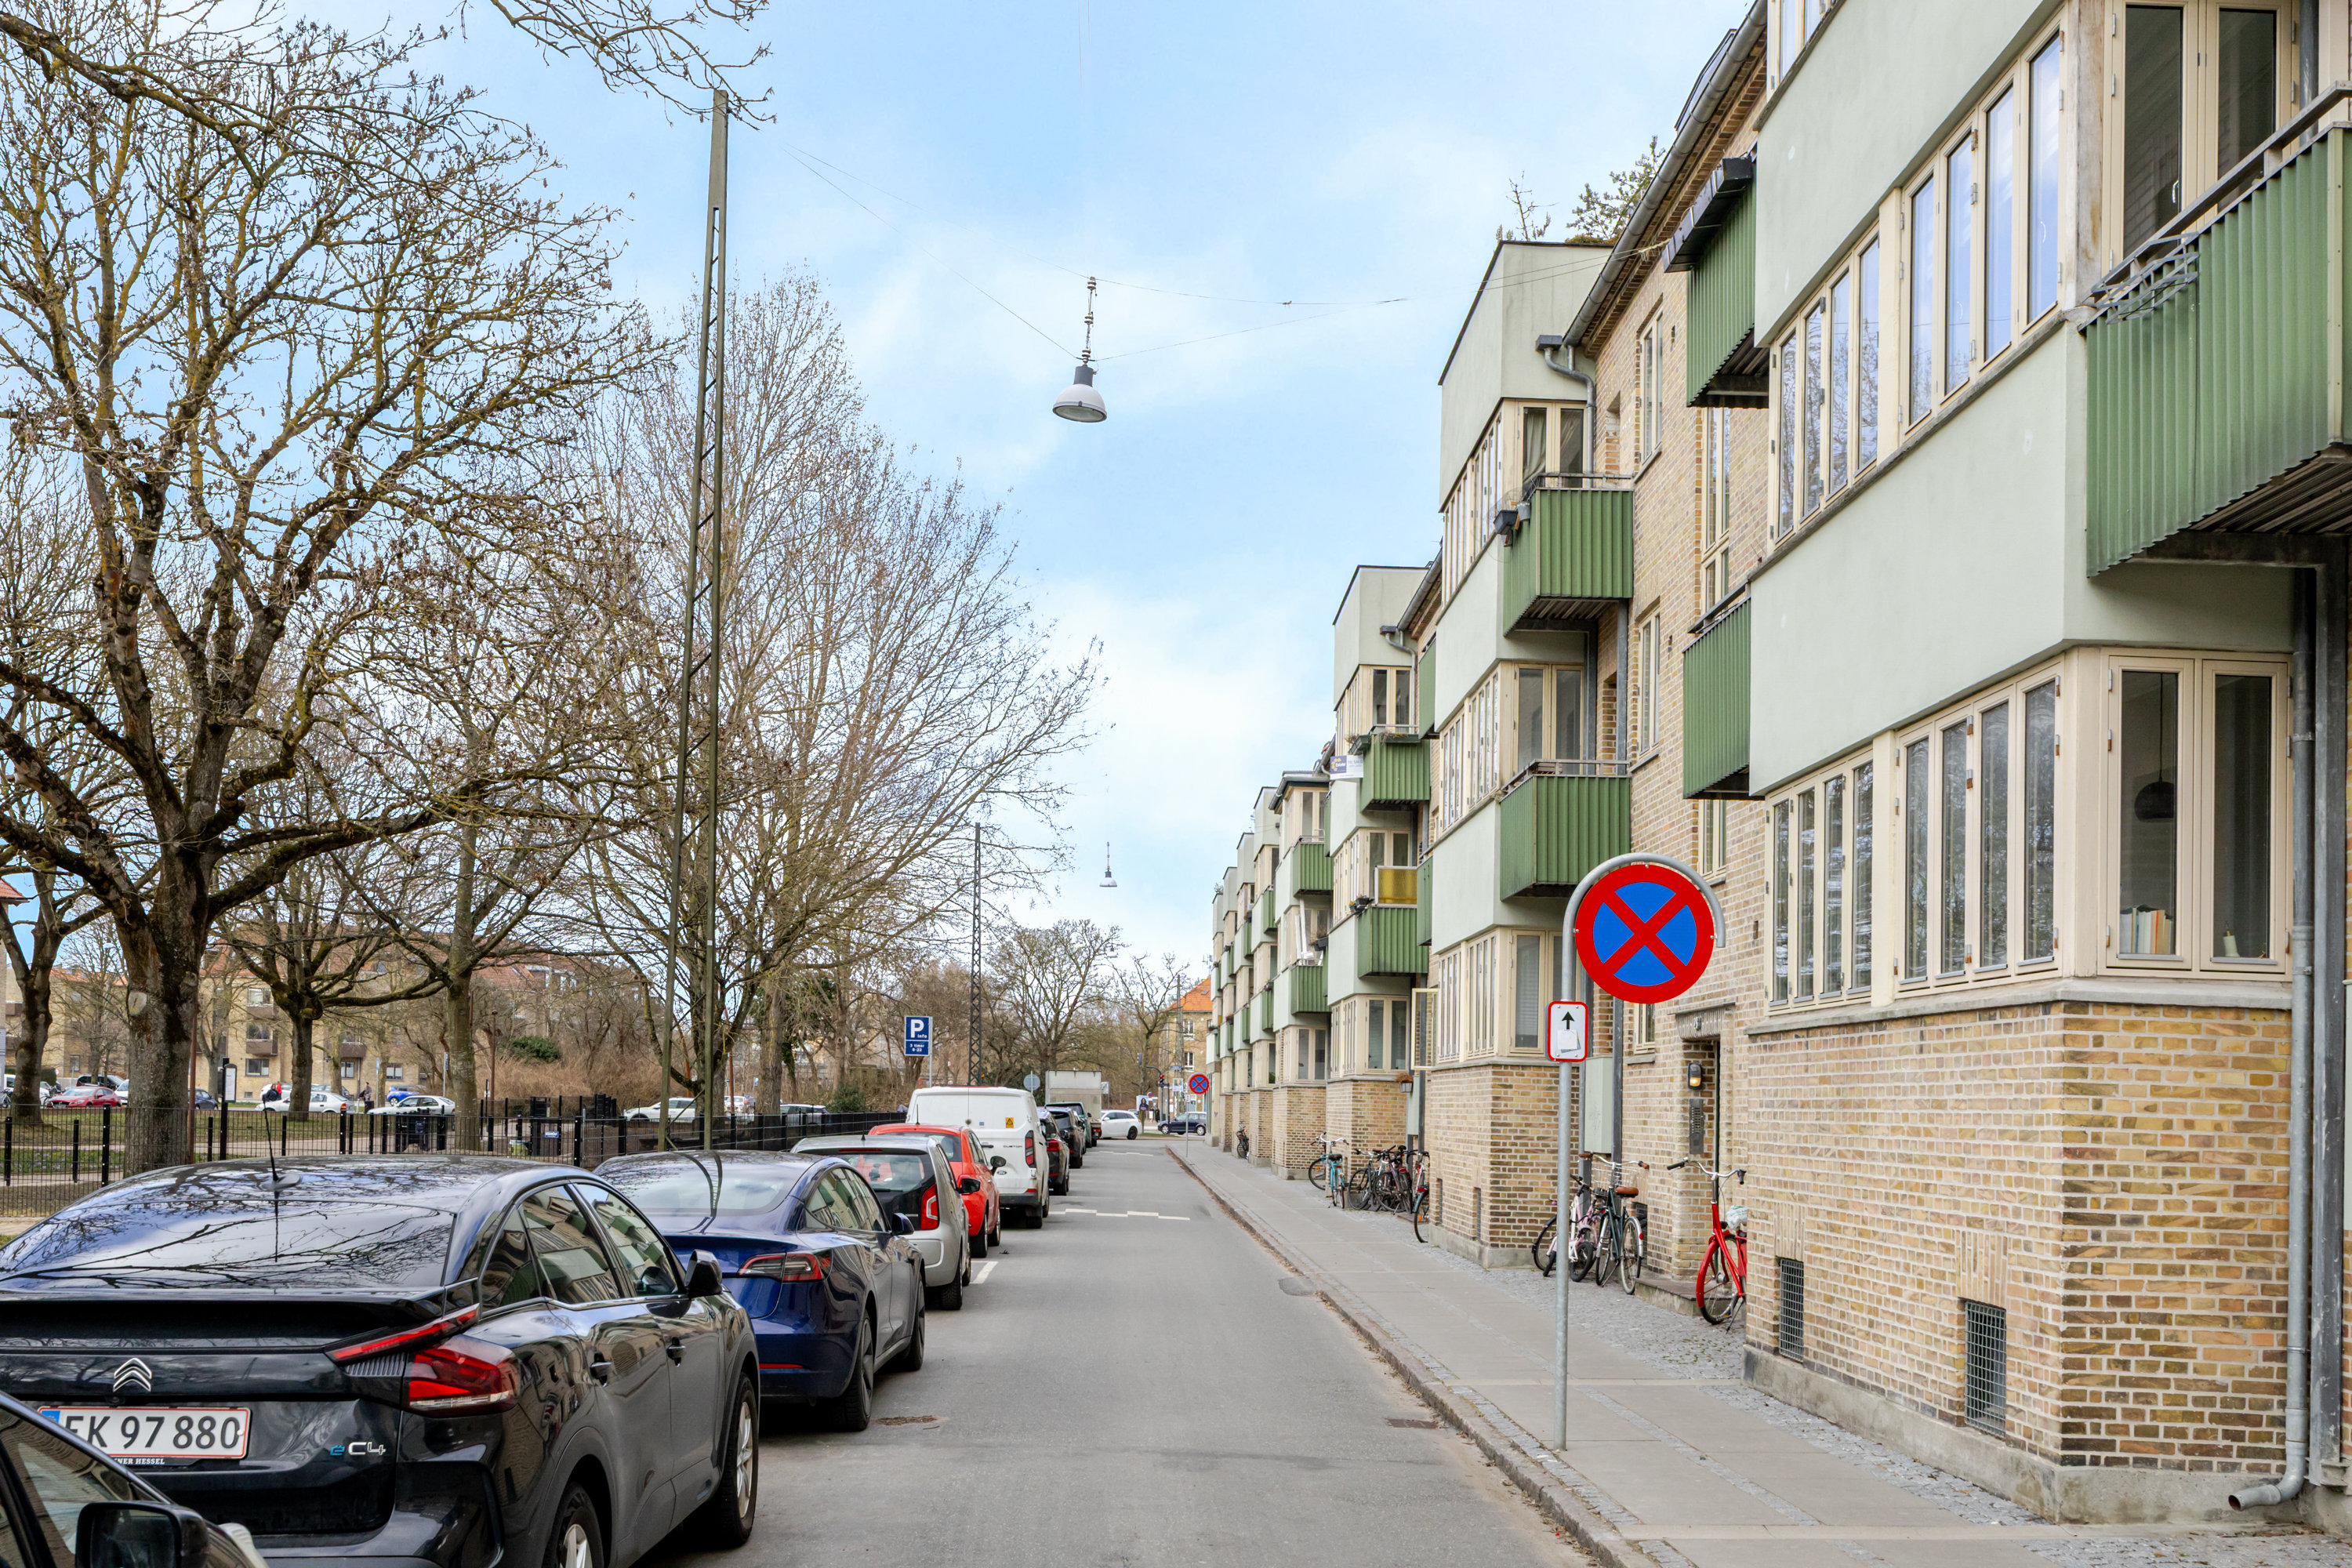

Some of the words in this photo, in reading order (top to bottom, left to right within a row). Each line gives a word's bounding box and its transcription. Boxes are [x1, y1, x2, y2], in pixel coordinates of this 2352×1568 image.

[910, 1019, 924, 1038] P
[121, 1416, 165, 1449] 97
[172, 1415, 240, 1449] 880
